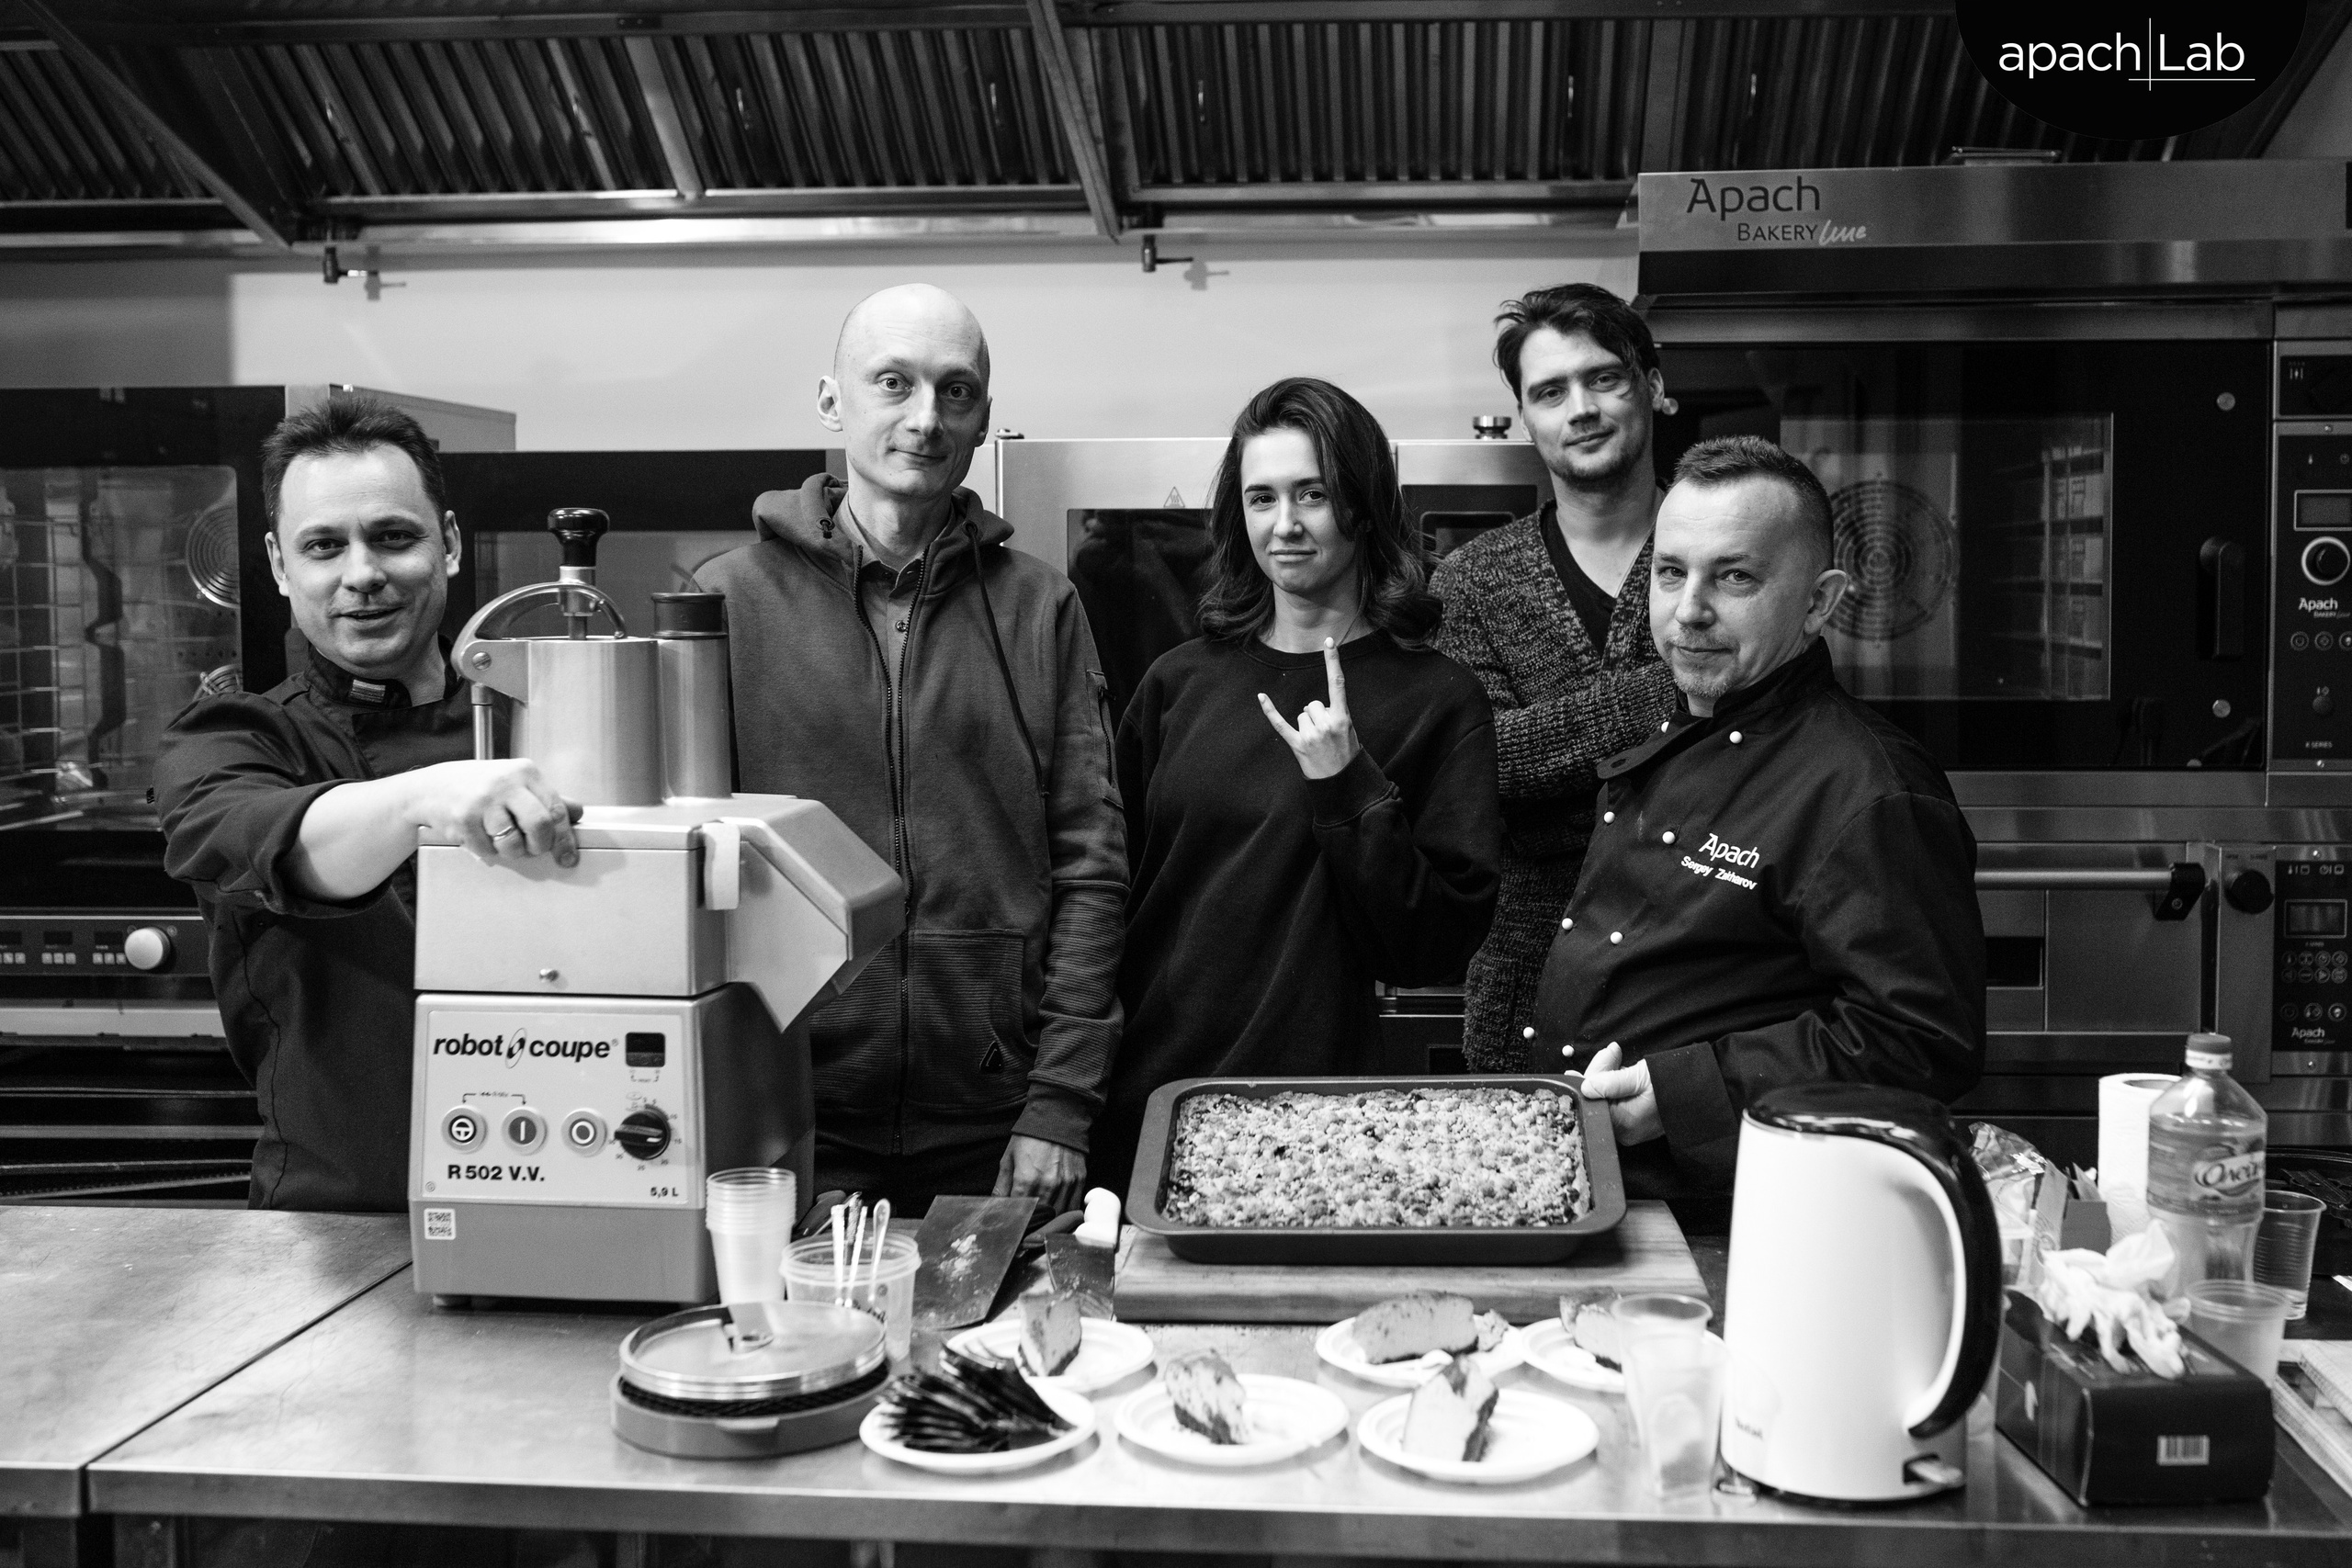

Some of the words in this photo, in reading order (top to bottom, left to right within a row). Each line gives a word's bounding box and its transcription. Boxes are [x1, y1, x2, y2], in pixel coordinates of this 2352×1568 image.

[1687, 175, 1820, 221] Apach
[1737, 222, 1818, 242] BAKERY
[2299, 597, 2338, 613] Apach
[1699, 832, 1760, 869] Apach
[1681, 855, 1714, 877] Sergey
[2290, 1026, 2325, 1039] Apach
[433, 1032, 503, 1055] robot
[529, 1039, 611, 1063] coupe
[447, 1164, 461, 1179] R
[465, 1165, 503, 1180] 502
[508, 1166, 545, 1181] V.V.
[672, 1187, 680, 1197] L
